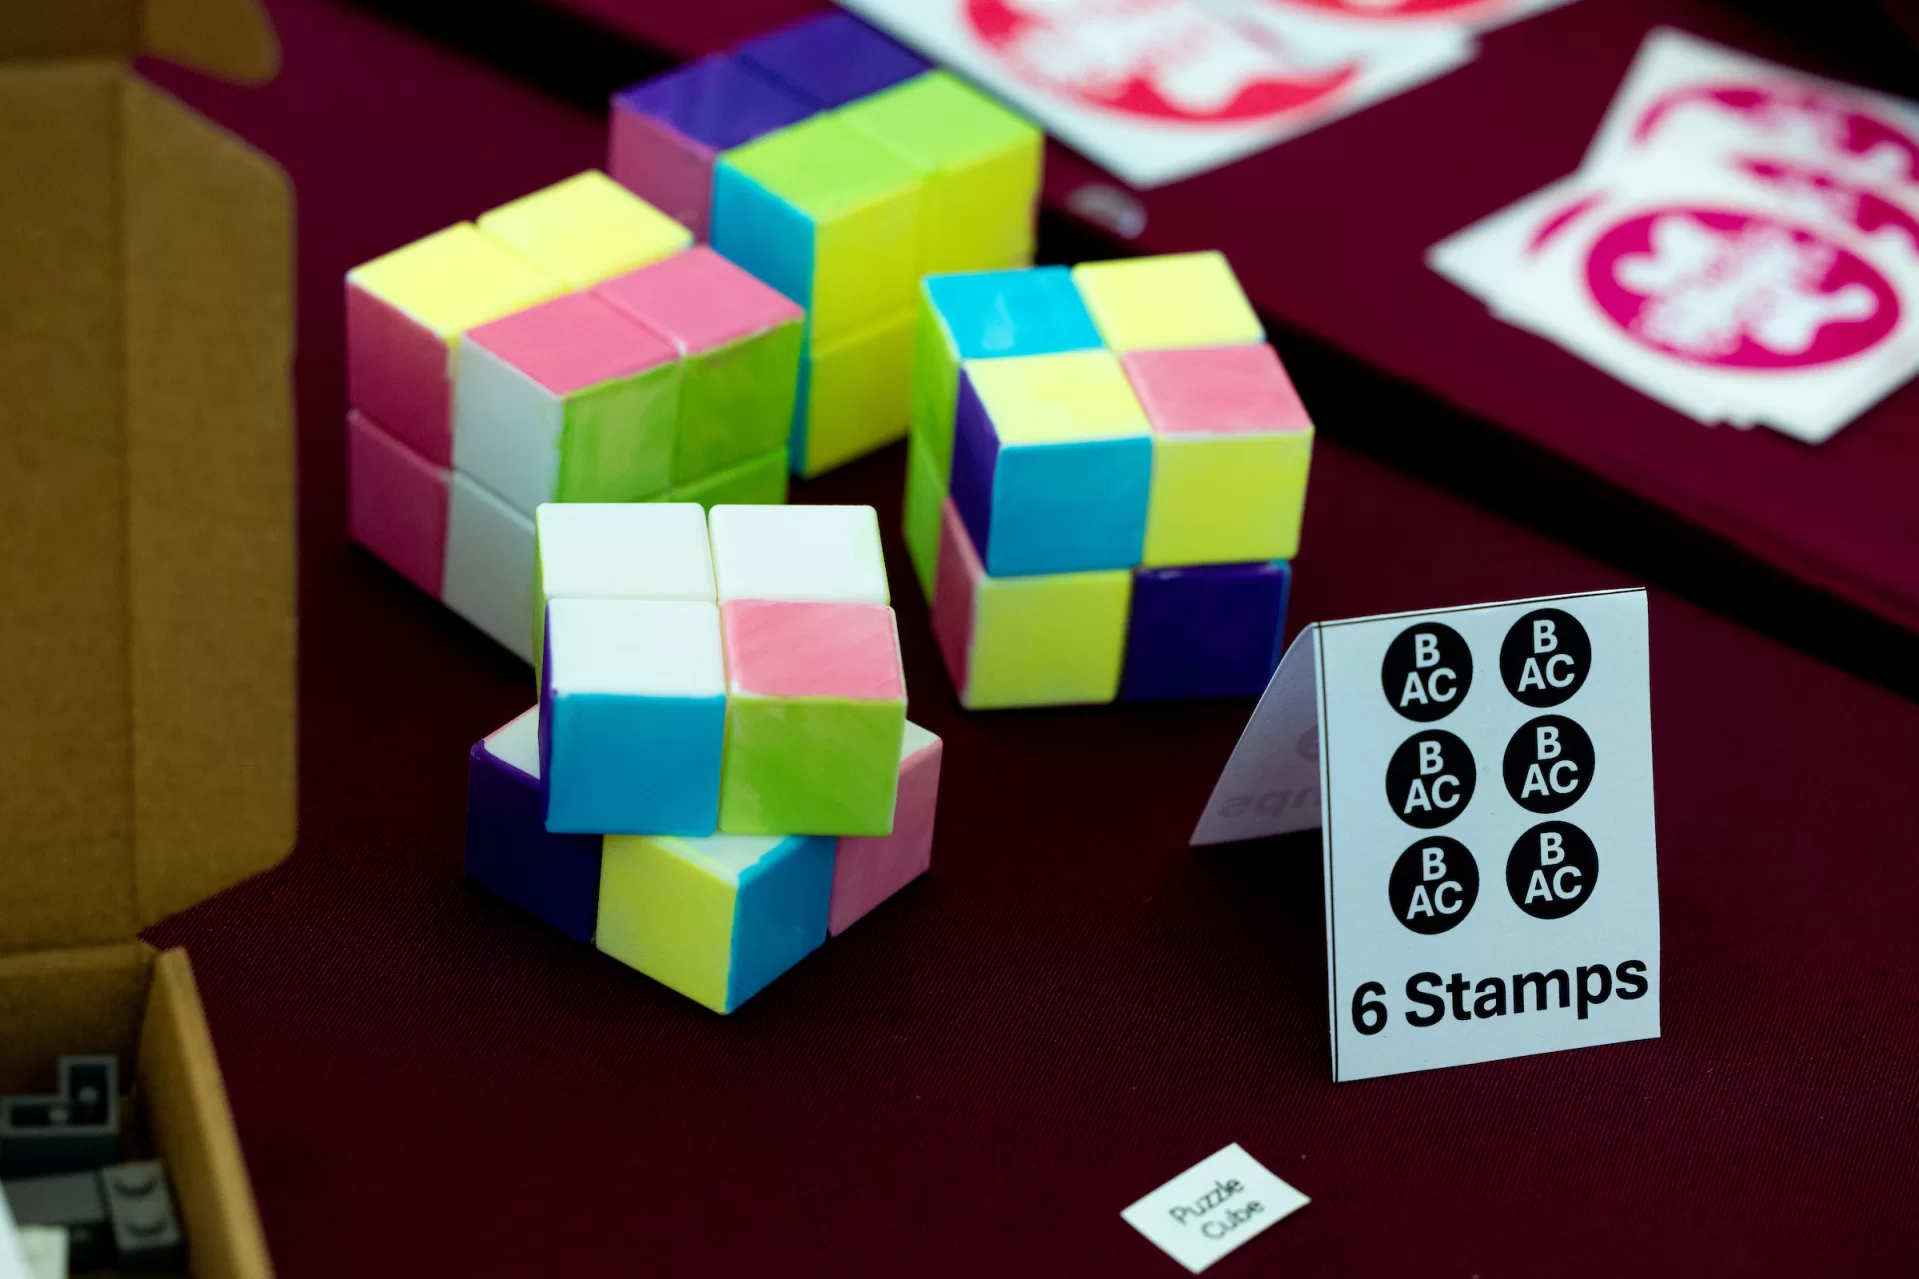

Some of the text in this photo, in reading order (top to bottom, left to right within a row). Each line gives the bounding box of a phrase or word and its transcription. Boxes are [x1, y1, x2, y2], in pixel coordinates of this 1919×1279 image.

[1415, 634, 1441, 668] B
[1534, 620, 1558, 653] B
[1399, 668, 1457, 707] AC
[1518, 654, 1575, 692] AC
[1419, 741, 1444, 775] B
[1537, 726, 1562, 760] B
[1404, 775, 1460, 814] AC
[1521, 760, 1579, 798] AC
[1422, 847, 1447, 882] B
[1539, 832, 1565, 866] B
[1407, 881, 1463, 919] AC
[1525, 866, 1582, 904] AC
[1352, 959, 1649, 1036] 6 Stamps
[1169, 1179, 1244, 1225] Puzzle
[1201, 1200, 1265, 1239] Cube
